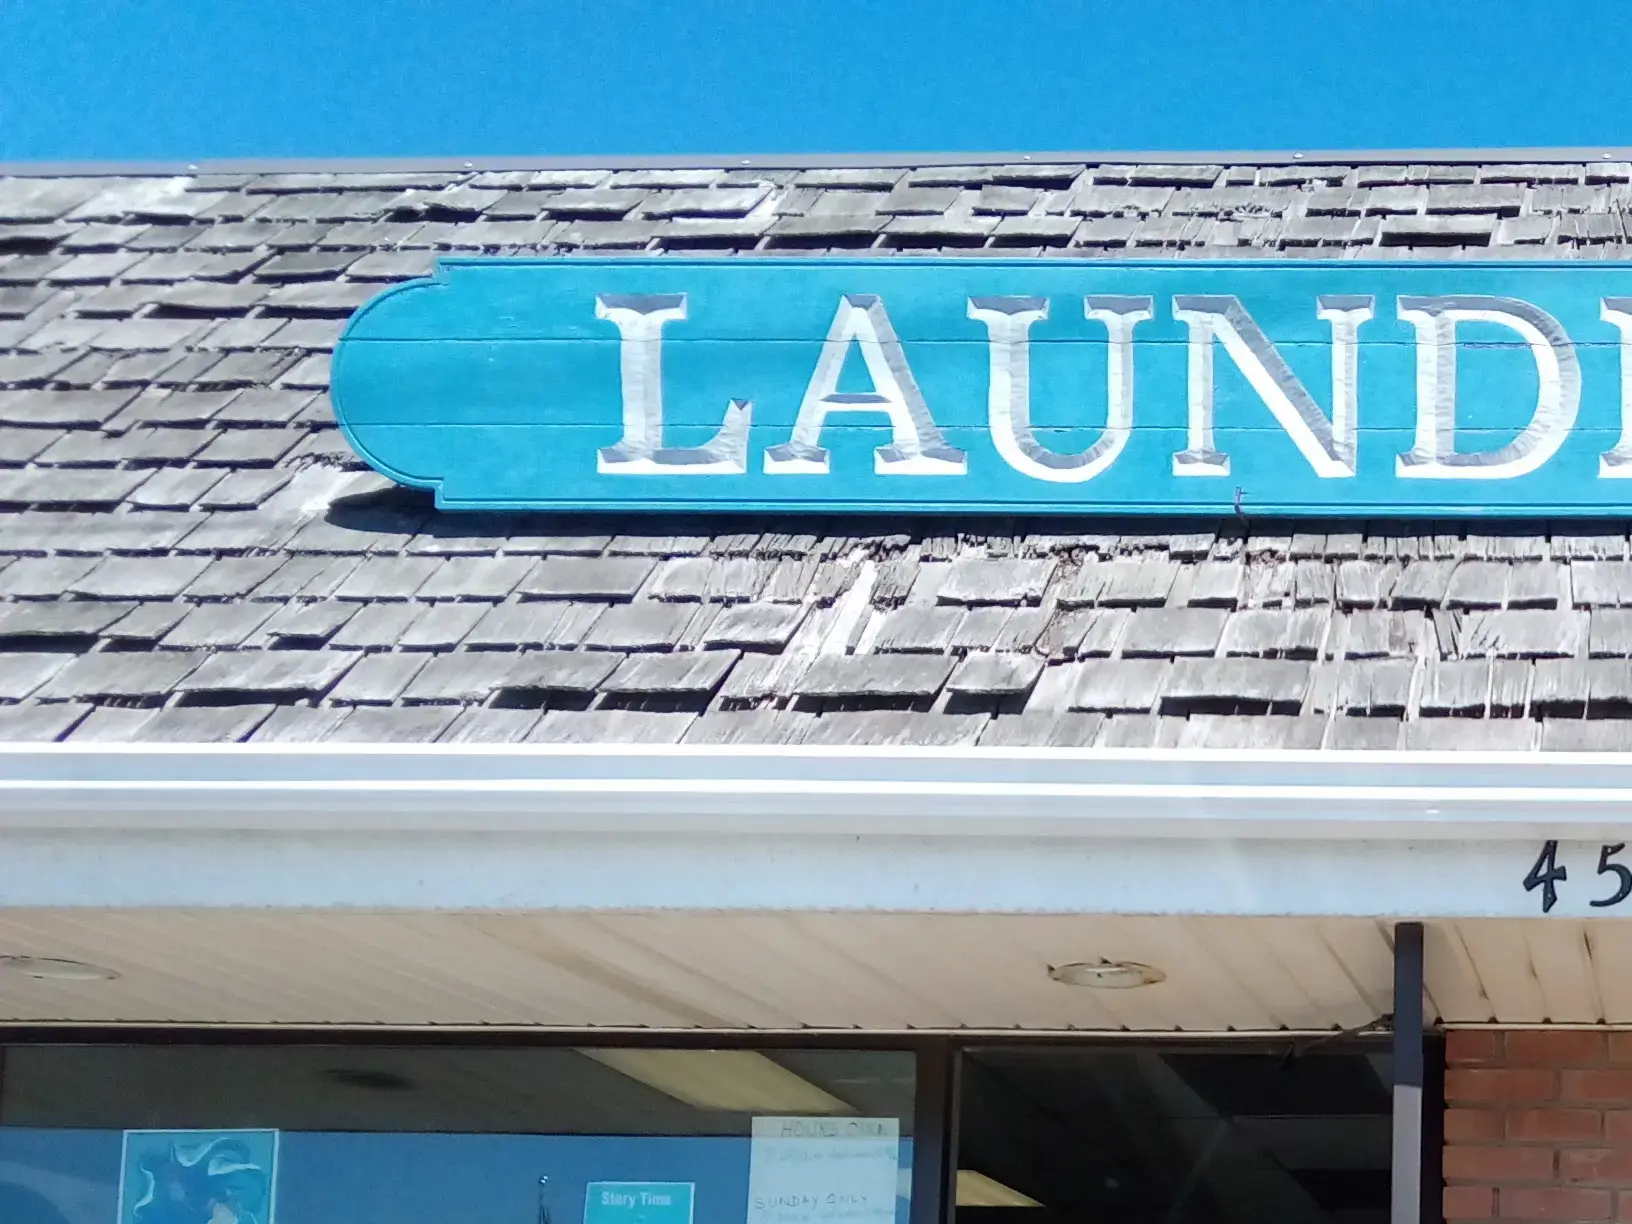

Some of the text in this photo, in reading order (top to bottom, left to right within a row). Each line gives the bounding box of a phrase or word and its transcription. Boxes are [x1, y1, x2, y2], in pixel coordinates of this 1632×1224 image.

[1522, 840, 1632, 913] 45
[601, 1191, 672, 1208] Story Time
[754, 1194, 819, 1210] SUNDAY
